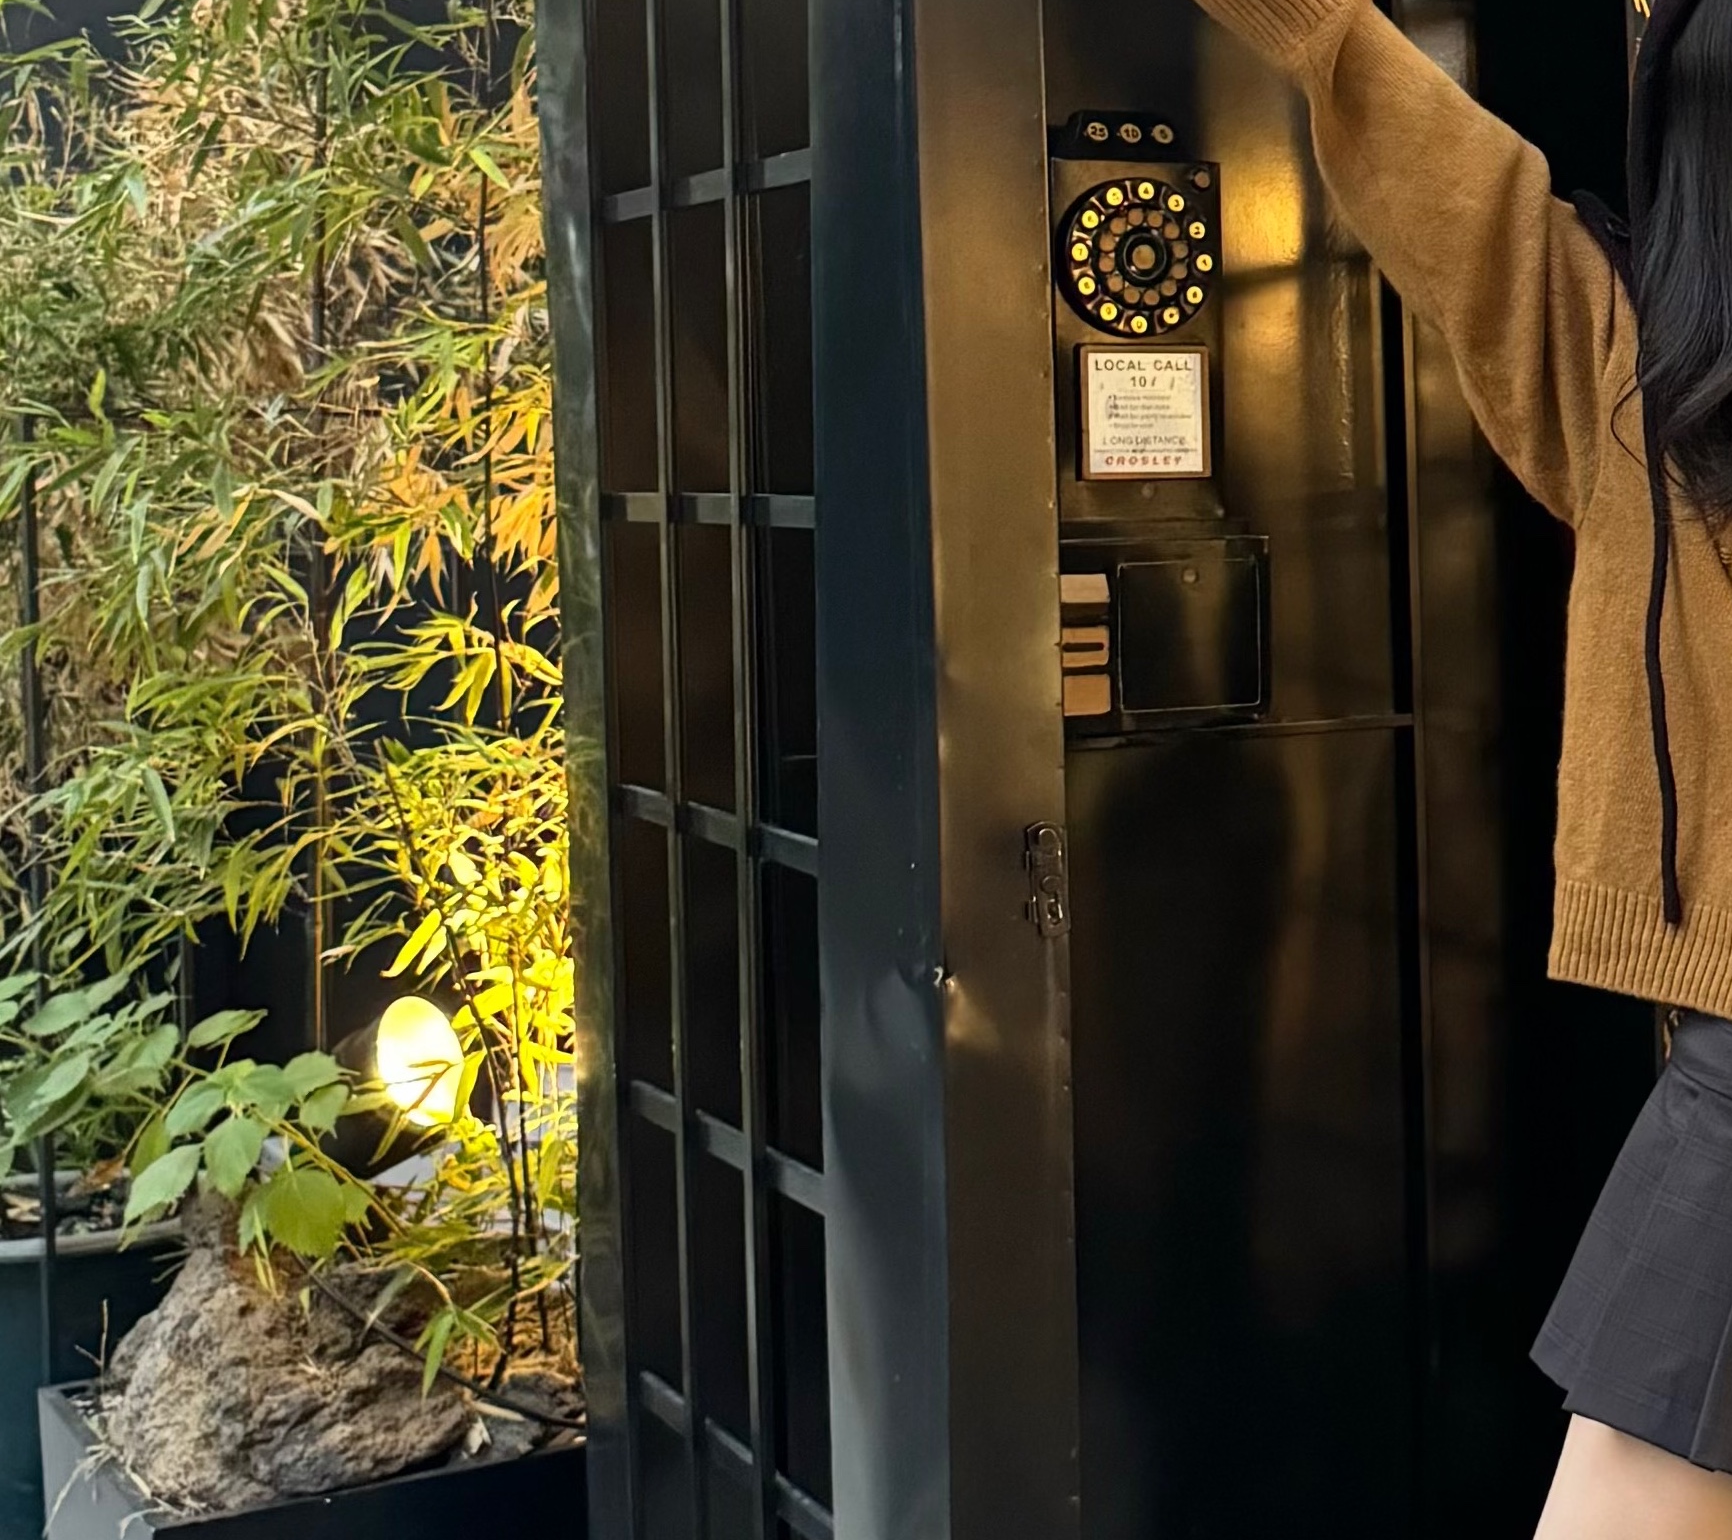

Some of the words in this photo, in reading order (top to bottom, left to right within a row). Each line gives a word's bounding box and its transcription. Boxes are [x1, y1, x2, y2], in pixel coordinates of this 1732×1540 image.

[1094, 359, 1146, 371] LOCAL
[1153, 359, 1193, 371] CALL
[1105, 456, 1183, 466] CROSLEY
